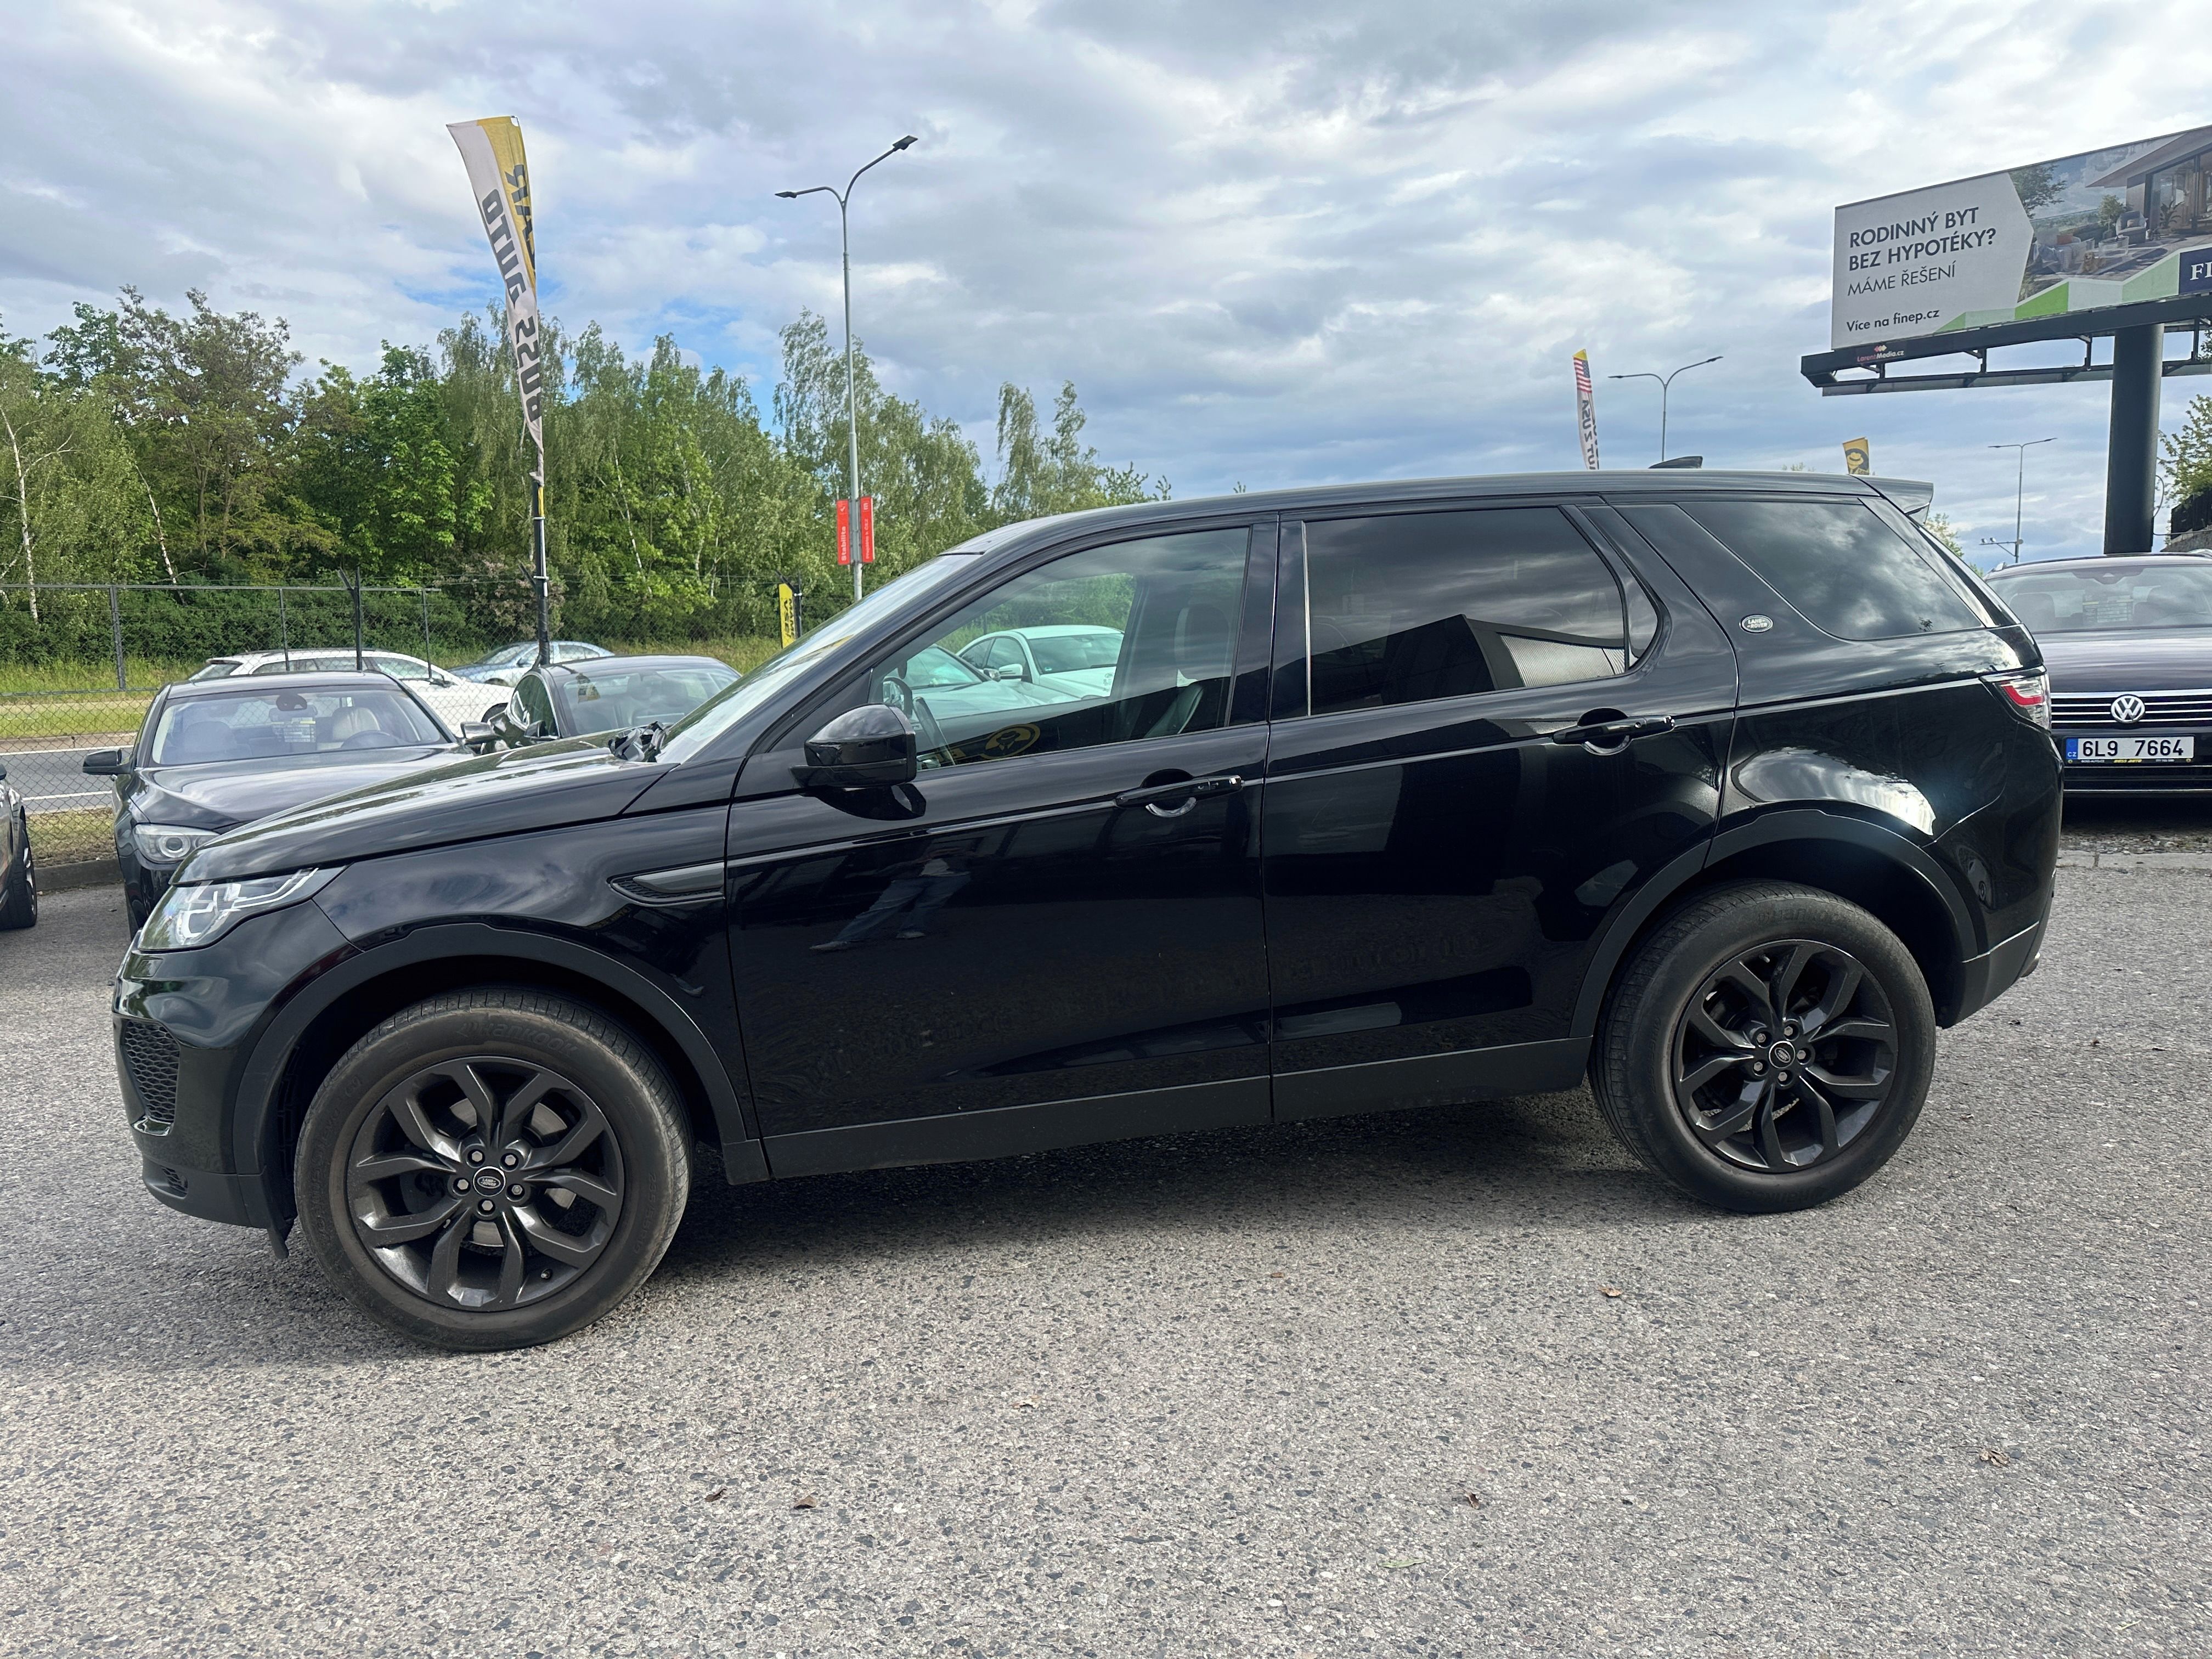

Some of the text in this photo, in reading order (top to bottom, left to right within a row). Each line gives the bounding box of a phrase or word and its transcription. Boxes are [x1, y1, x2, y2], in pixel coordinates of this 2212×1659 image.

[1849, 206, 1979, 248] RODINNÝ BYT
[1849, 228, 1996, 271] BEZ HYPOTÉKY?
[1847, 260, 1956, 296] MÁME ŘEŠENÍ
[1847, 309, 1940, 332] Více na finep.cz
[1857, 350, 1905, 362] LarentMedia.cz
[2083, 739, 2184, 757] 6L9 7664
